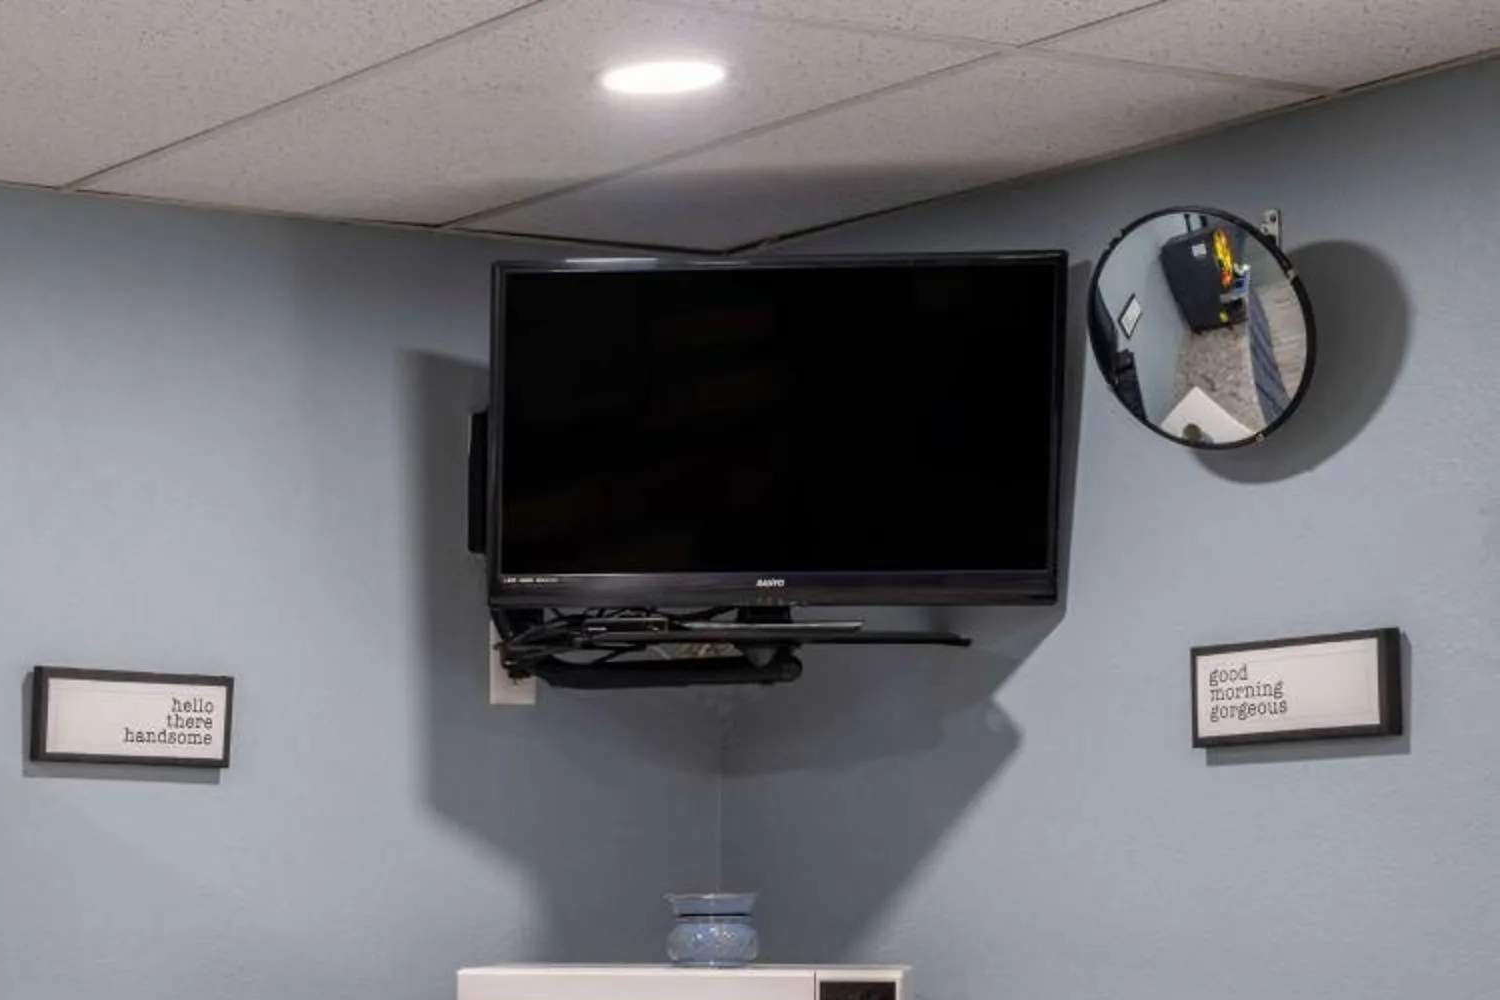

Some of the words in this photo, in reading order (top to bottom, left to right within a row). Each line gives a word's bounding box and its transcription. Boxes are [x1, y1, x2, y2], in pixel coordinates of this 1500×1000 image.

[1209, 663, 1248, 686] good
[1209, 680, 1284, 701] morning
[171, 697, 214, 713] hello
[1209, 700, 1288, 722] gorgeous
[166, 713, 213, 729] there
[123, 727, 213, 745] handsome
